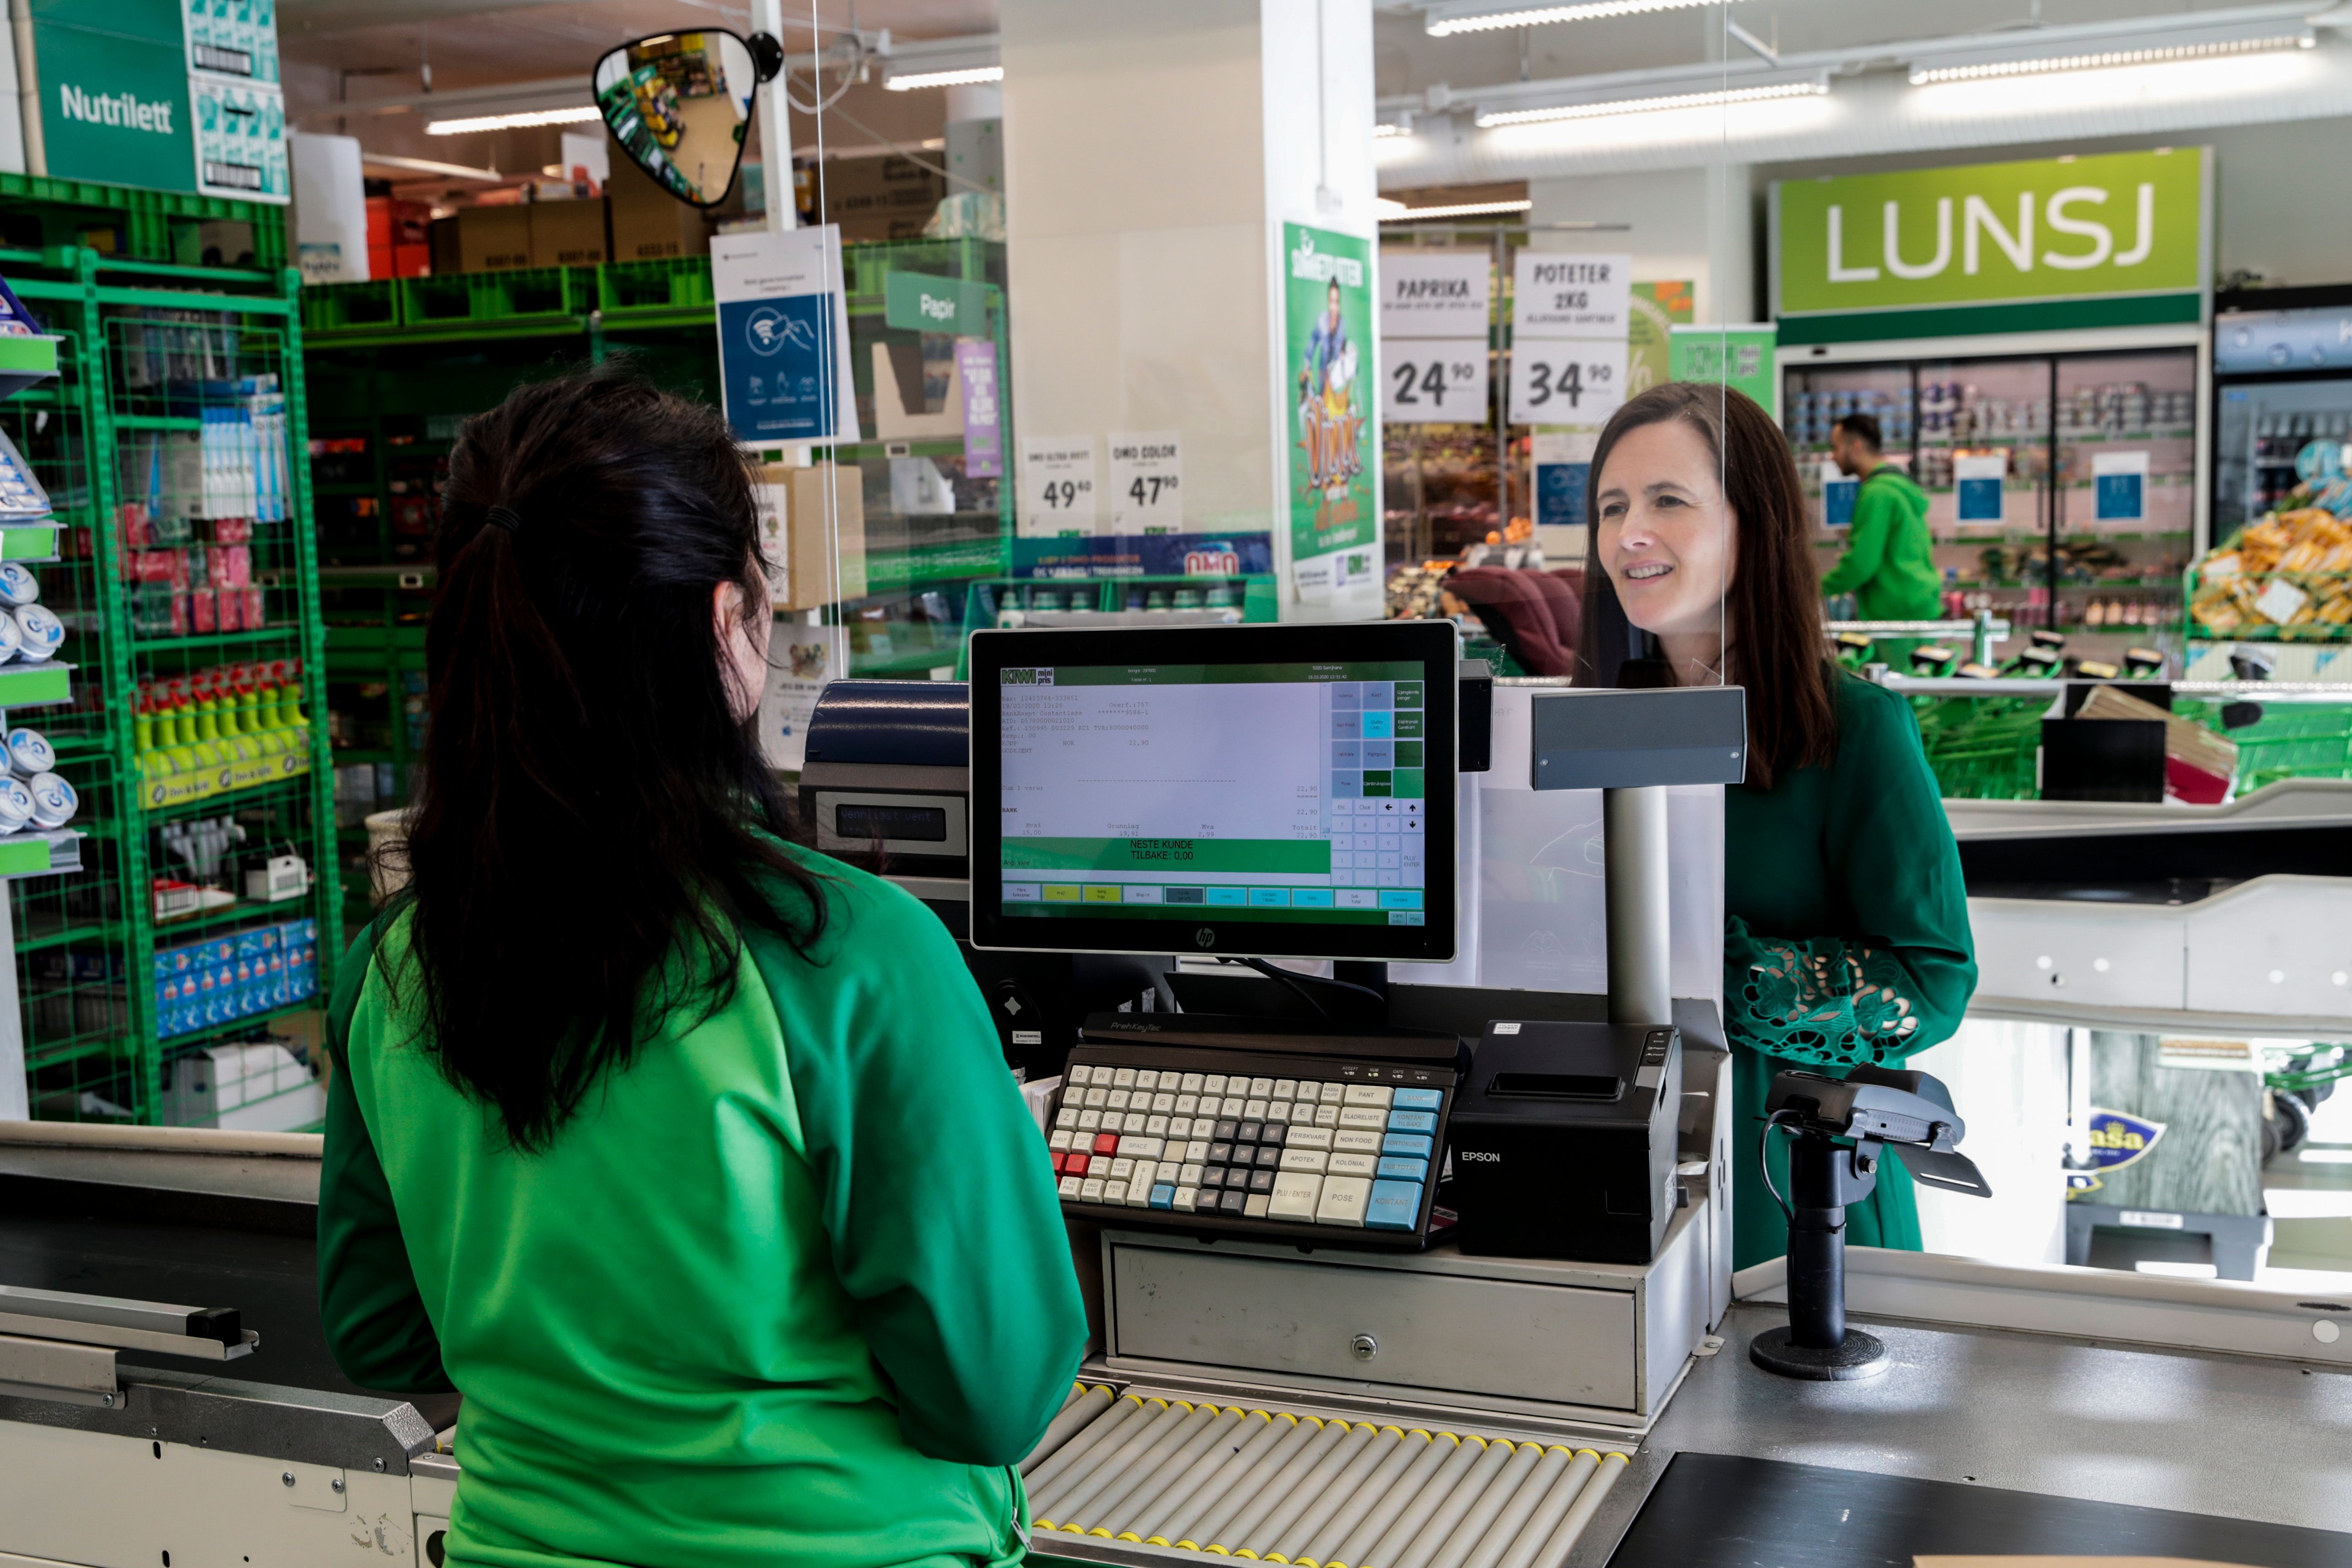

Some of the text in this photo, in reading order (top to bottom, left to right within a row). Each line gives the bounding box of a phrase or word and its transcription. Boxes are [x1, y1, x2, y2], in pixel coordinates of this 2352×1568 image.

[60, 84, 174, 134] Nutrilett
[1827, 183, 2154, 283] LUNSJ
[1534, 264, 1611, 284] POTETER
[1397, 279, 1469, 299] PAPRIKA
[920, 293, 955, 321] Papir
[1555, 291, 1588, 310] 2KG
[1393, 362, 1474, 407] 24 90
[1529, 362, 1611, 408] 34 90
[1113, 444, 1176, 460] OMO COLOR
[1043, 480, 1075, 509] 49
[1128, 475, 1179, 507] 47 90
[1184, 550, 1240, 575] OMO
[1001, 669, 1036, 684] KIWI
[842, 808, 931, 822] Vennligst vent
[1130, 840, 1193, 849] NESTE KUNDE
[1130, 850, 1193, 860] TILBAKE: 0,00
[1110, 1022, 1161, 1032] PrehKeyTec
[1304, 1085, 1310, 1094] Å
[1269, 1129, 1276, 1138] 9
[1290, 1132, 1326, 1141] FERSKVARE
[1462, 1151, 1500, 1162] EPSON
[1135, 1167, 1146, 1194] SLETT
[1332, 1194, 1353, 1202] POSE
